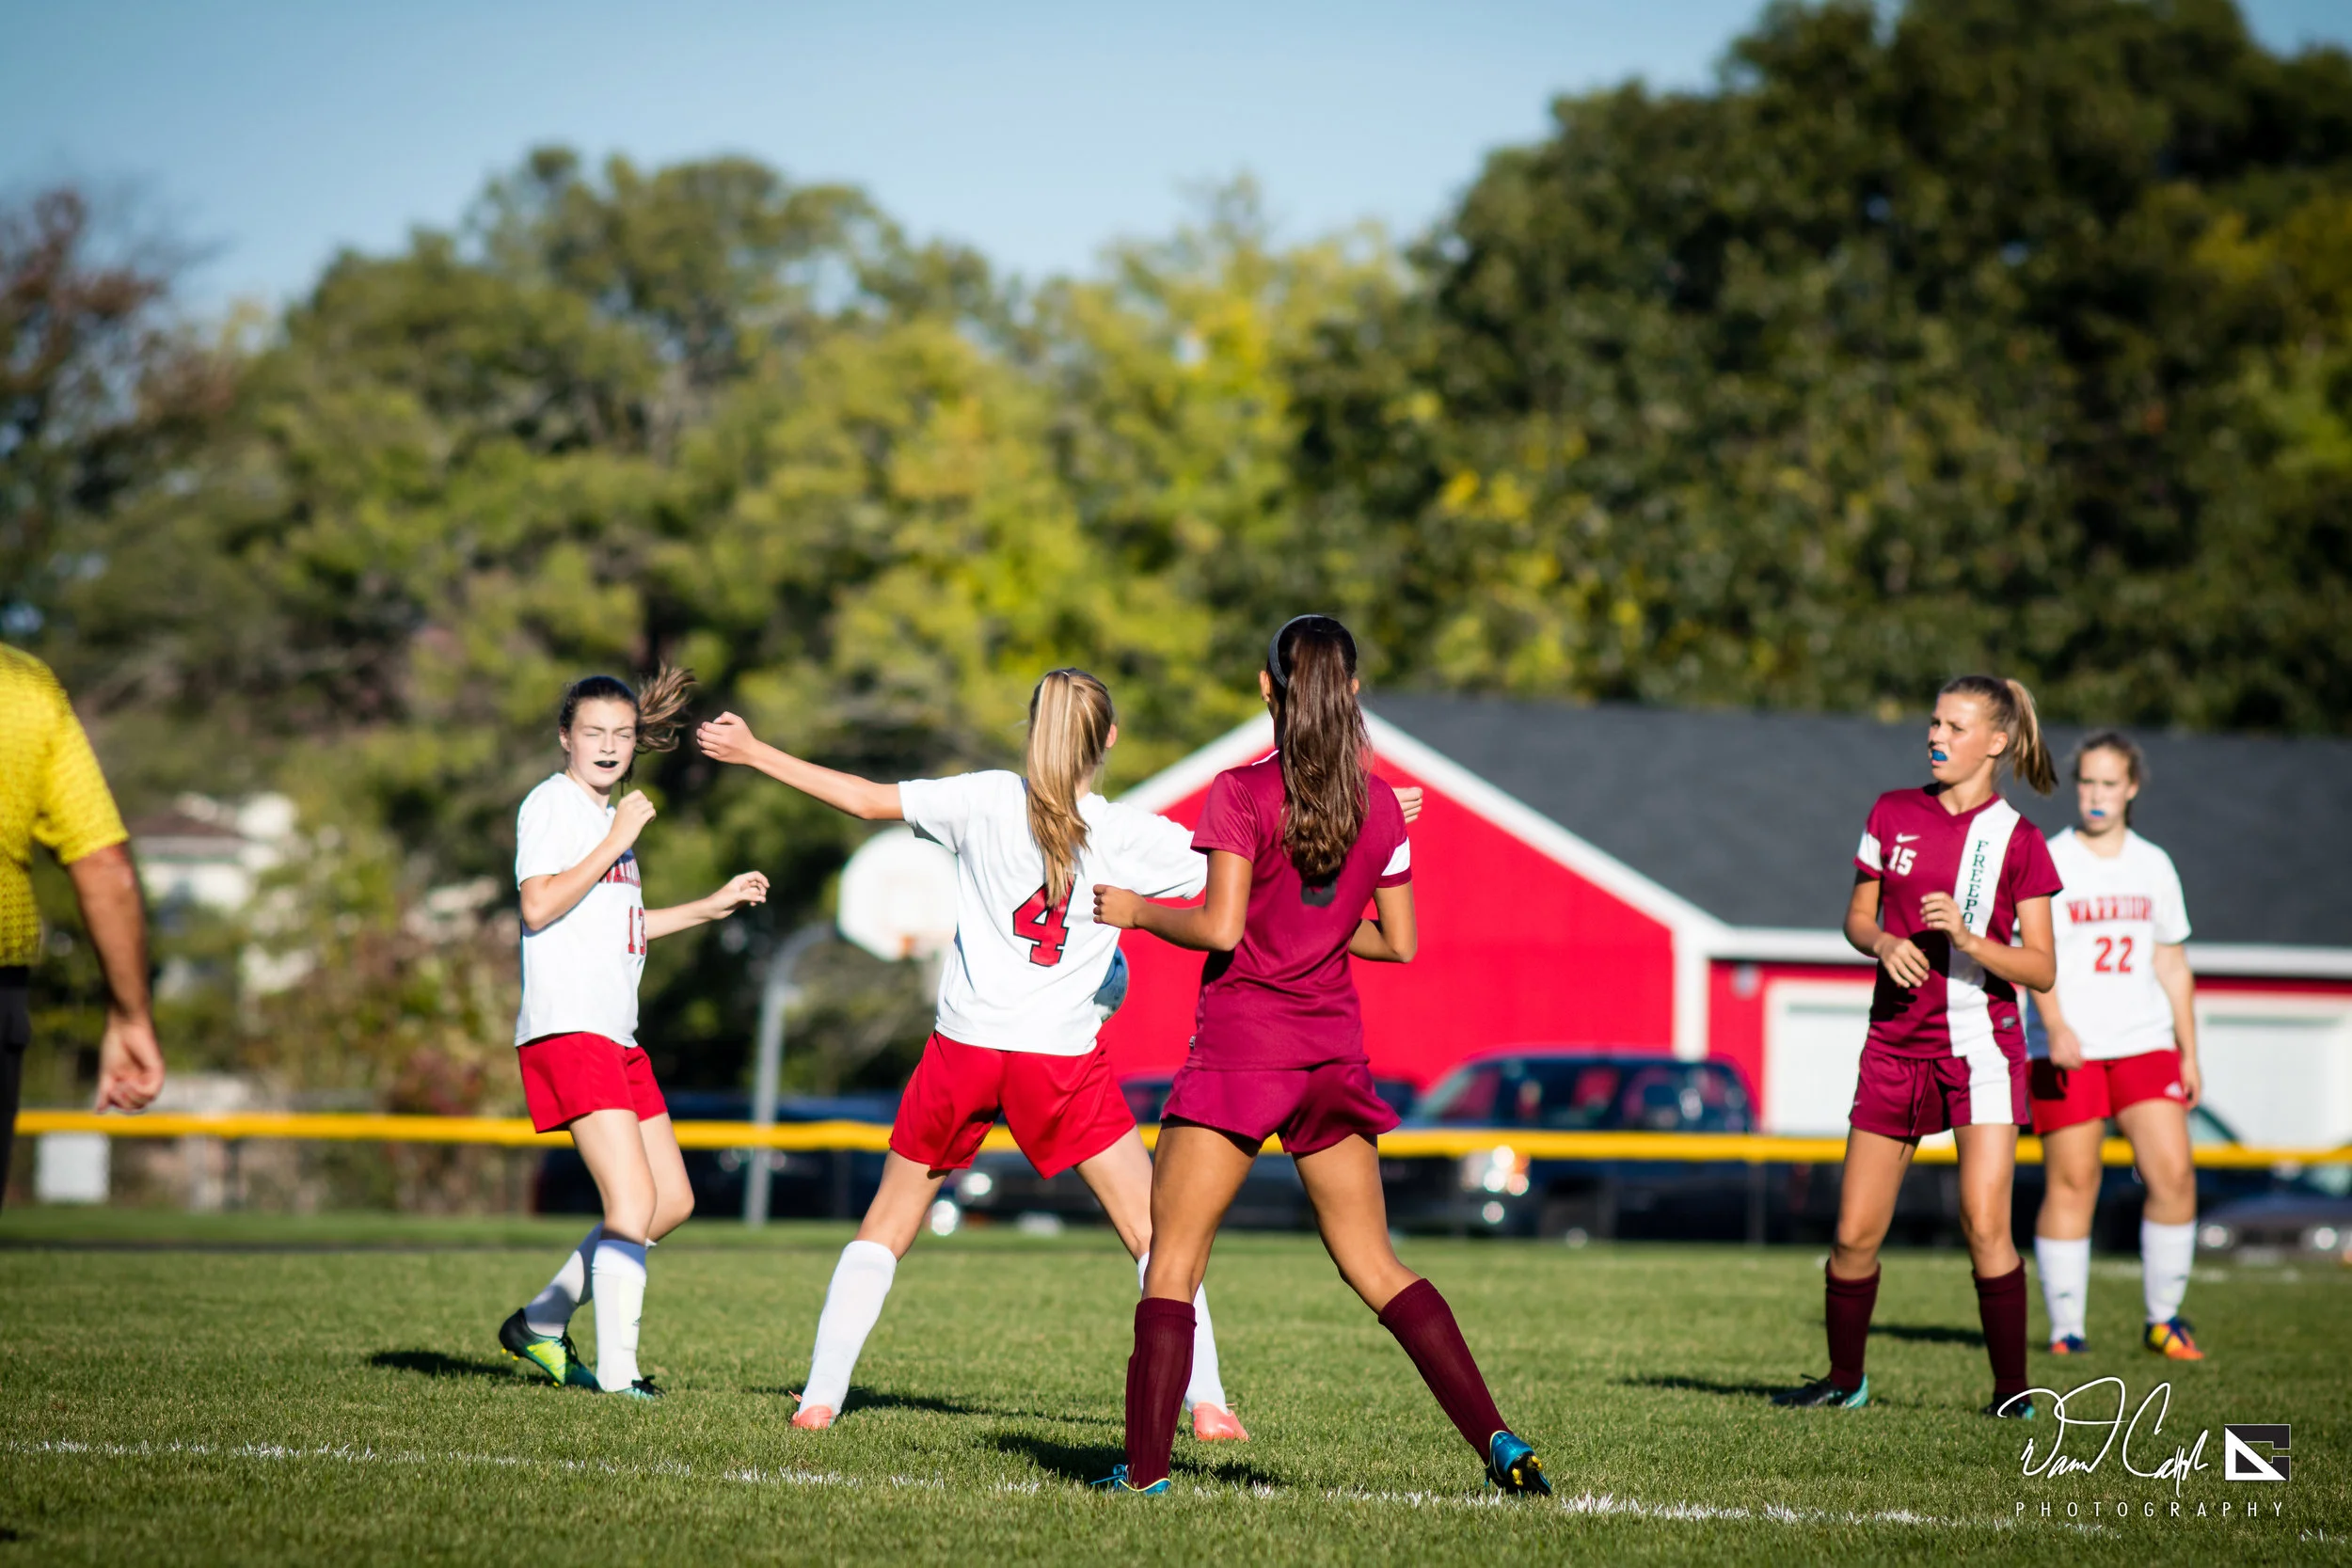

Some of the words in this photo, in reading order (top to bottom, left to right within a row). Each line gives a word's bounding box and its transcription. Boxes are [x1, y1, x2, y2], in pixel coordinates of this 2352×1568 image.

[1888, 845, 1917, 877] 15
[1963, 840, 1989, 931] FREEPO
[1012, 874, 1078, 968] 4
[2094, 935, 2134, 974] 22
